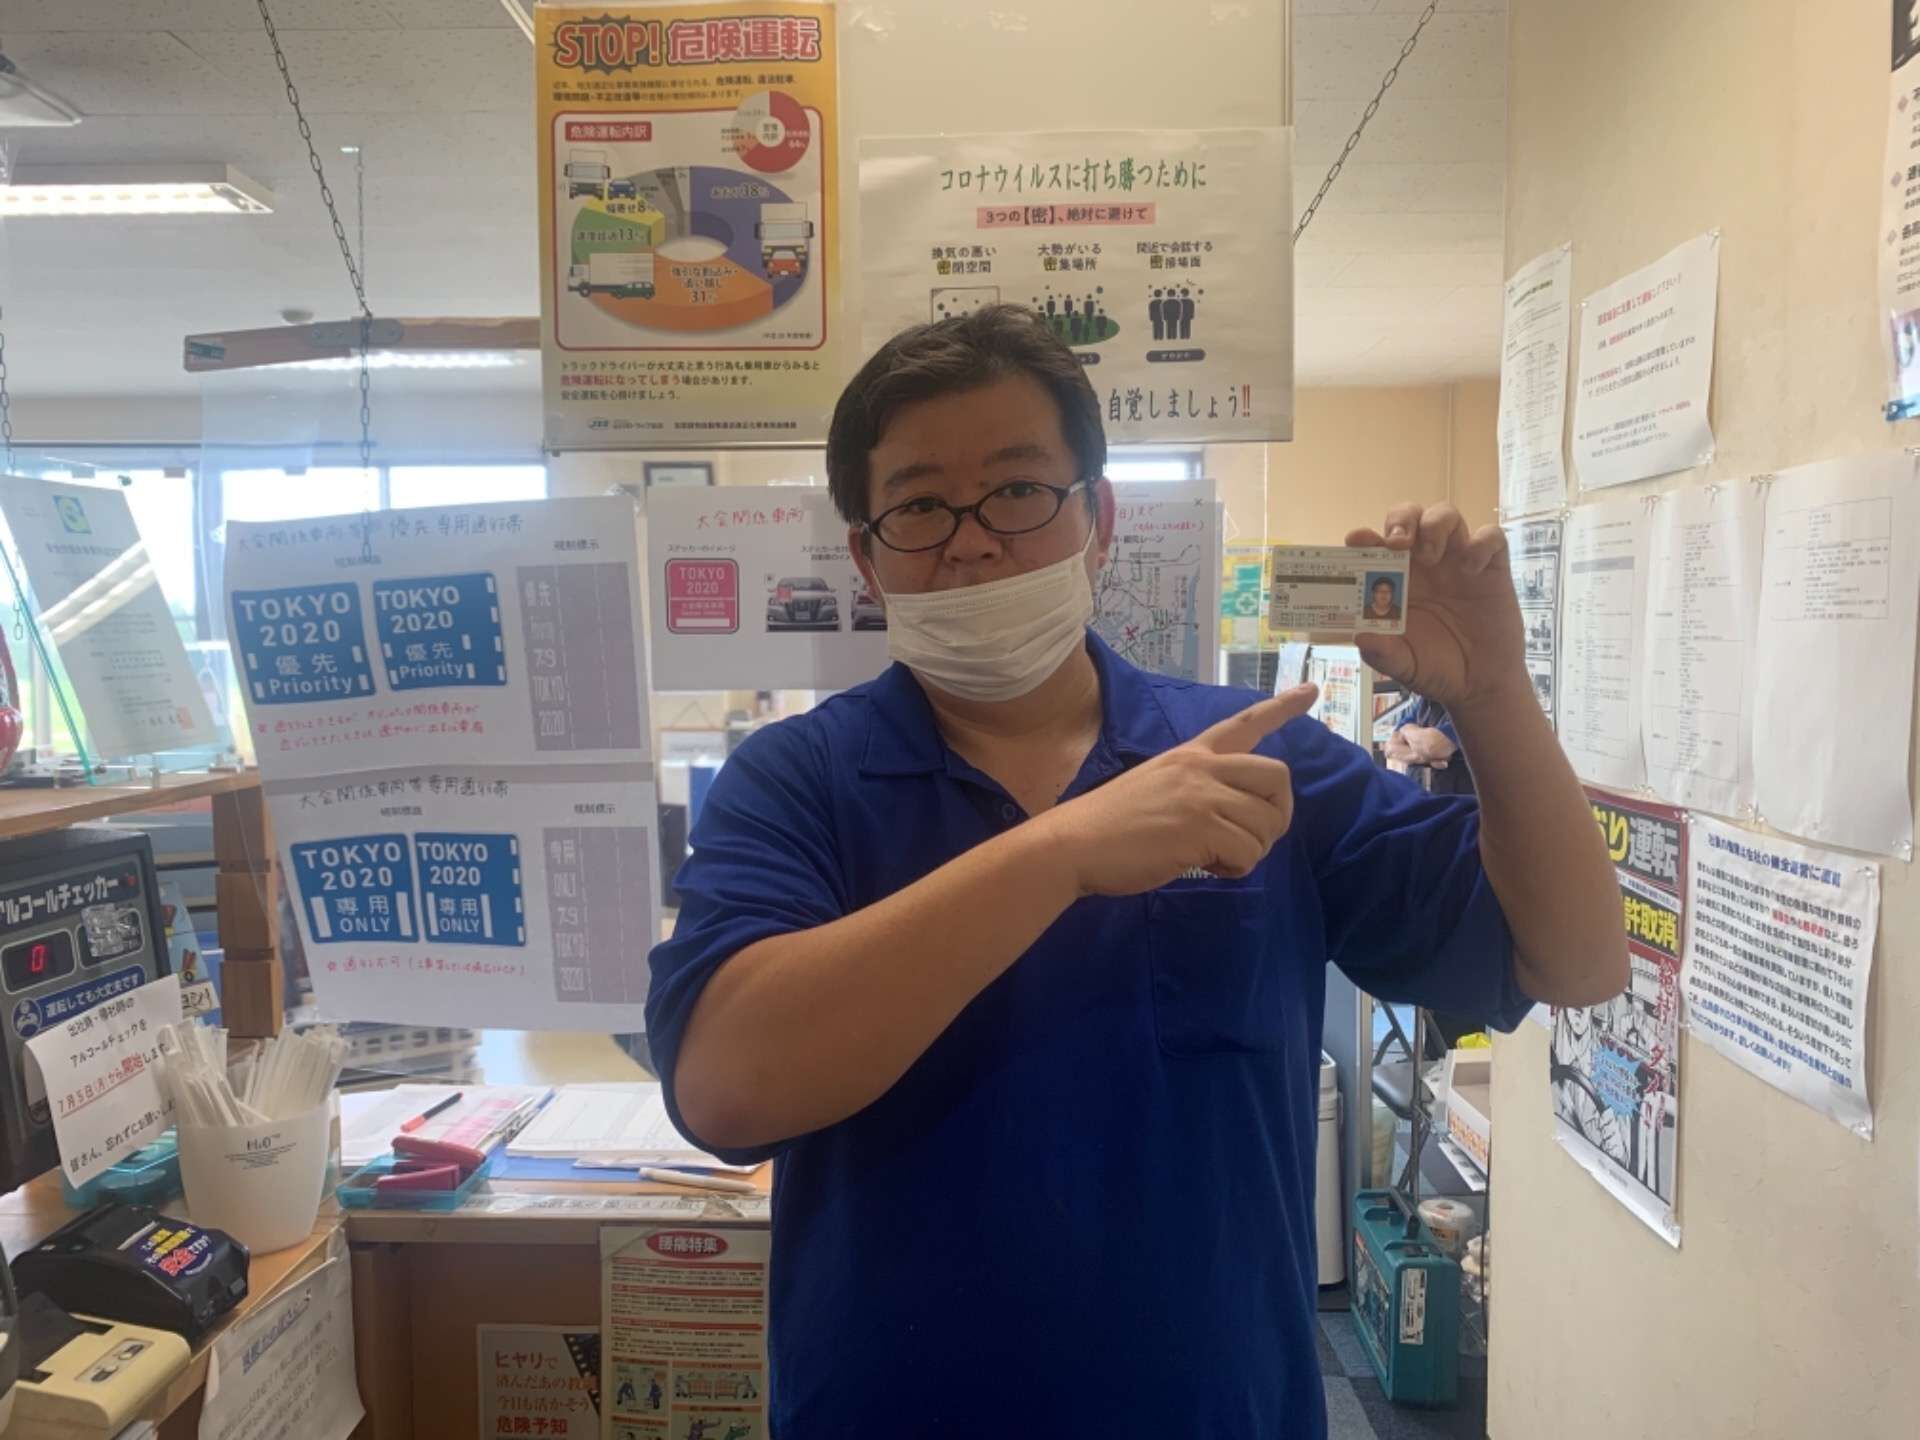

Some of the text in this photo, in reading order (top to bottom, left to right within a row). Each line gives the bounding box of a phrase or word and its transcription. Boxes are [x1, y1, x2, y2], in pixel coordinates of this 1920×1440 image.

[556, 18, 820, 66] STOP! 危険運転
[940, 157, 1207, 192] コロナウイルスに打ち勝つために
[985, 206, 1148, 225] 3つの【密】、絶対に避けて
[931, 246, 998, 260] 換気の悪い
[1038, 244, 1102, 257] 大勢がいる
[1136, 241, 1214, 254] 間近で会話する
[937, 260, 992, 275] 密閉空間
[1044, 257, 1098, 271] 密集場所
[1150, 254, 1201, 269] 密接場面
[679, 566, 725, 580] TOKYO
[686, 581, 720, 595] 2020
[240, 592, 352, 622] TOKYO
[376, 585, 460, 611] TOKYO
[391, 610, 454, 635] 2020
[260, 620, 341, 647] 2020
[405, 641, 453, 661] 優先
[275, 652, 338, 675] 優先
[400, 662, 464, 681] Priority
[269, 675, 353, 697] Priority
[300, 841, 401, 870] TOKYO
[418, 842, 488, 863] TOKYO
[322, 866, 394, 891] 2020
[430, 865, 481, 886] 2020
[336, 896, 390, 915] 専用
[439, 898, 478, 916] 専用
[340, 917, 391, 934] ONLY
[440, 917, 480, 934] ONLY
[496, 1416, 568, 1434] 危険予知
